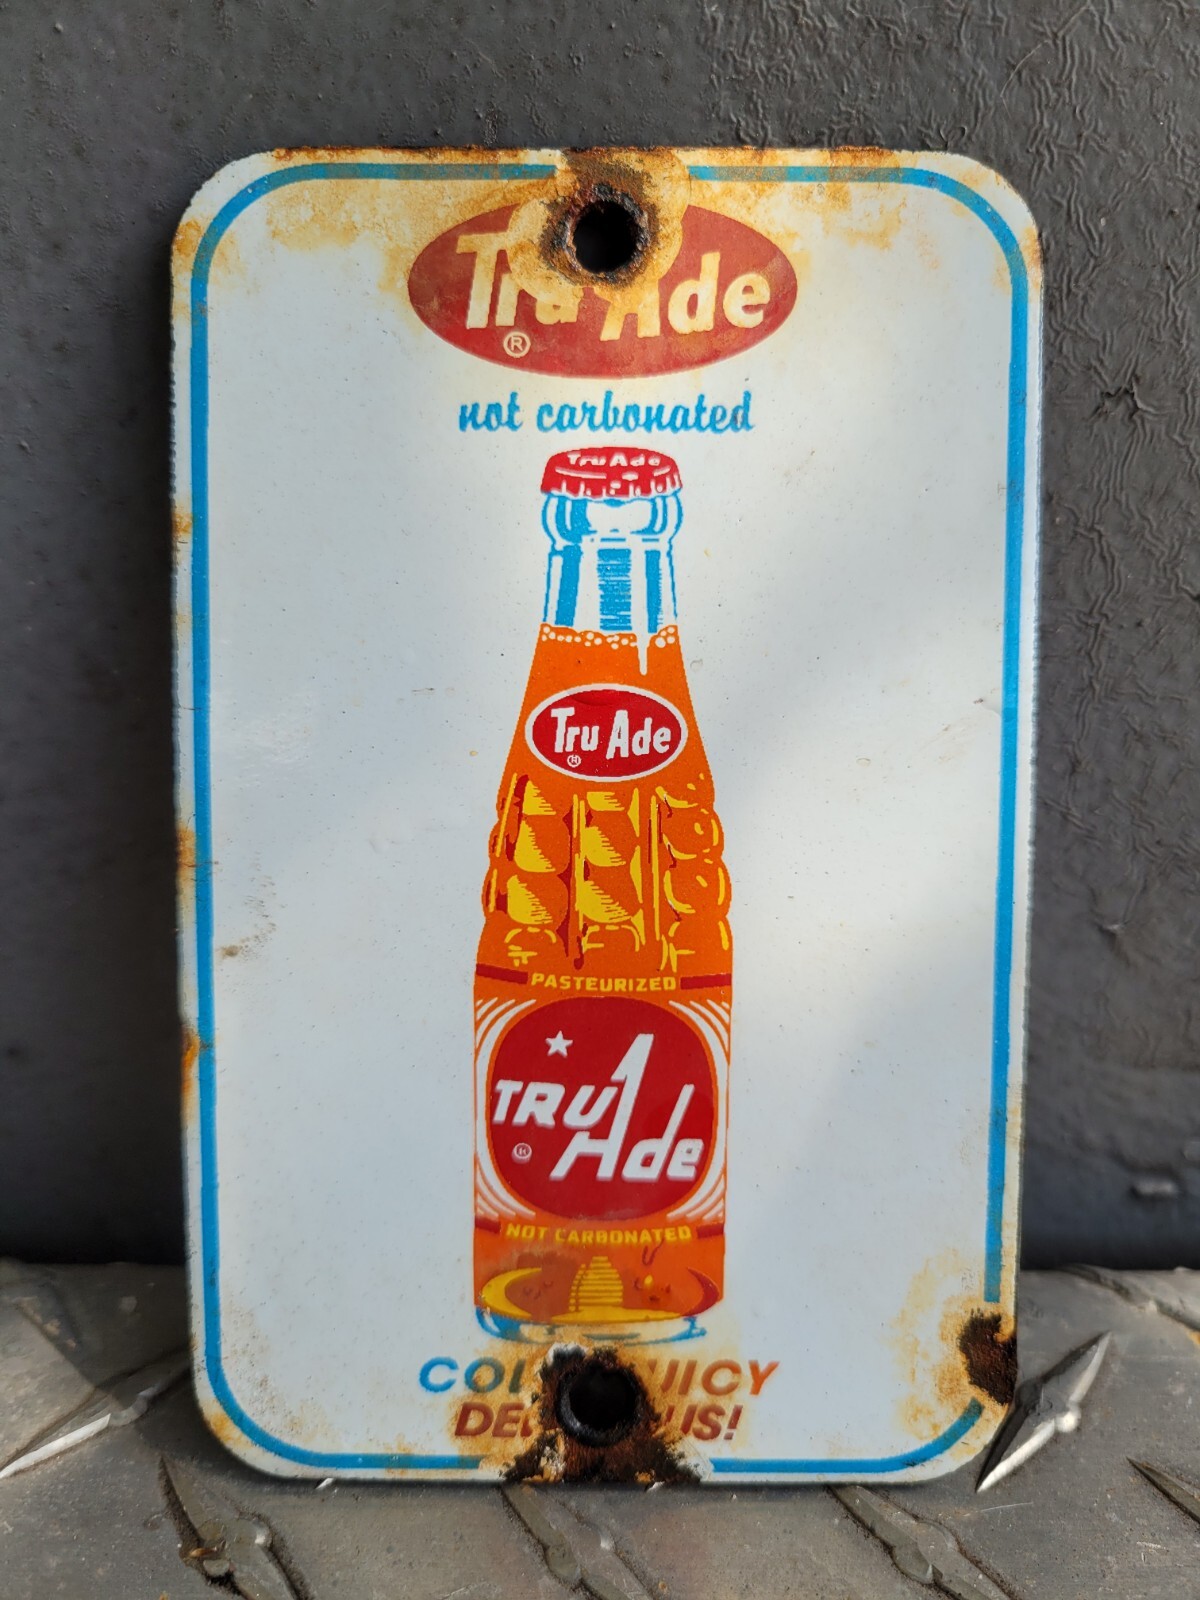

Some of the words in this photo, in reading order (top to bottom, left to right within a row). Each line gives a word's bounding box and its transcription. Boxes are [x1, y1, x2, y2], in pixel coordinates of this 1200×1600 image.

[458, 391, 522, 432] not
[535, 390, 755, 433] carbonated
[551, 706, 600, 753] Tru
[606, 709, 672, 760] Ade
[530, 972, 677, 993] PASTEURIZED
[506, 1222, 547, 1240] NOT
[554, 1224, 692, 1245] CARBONATED
